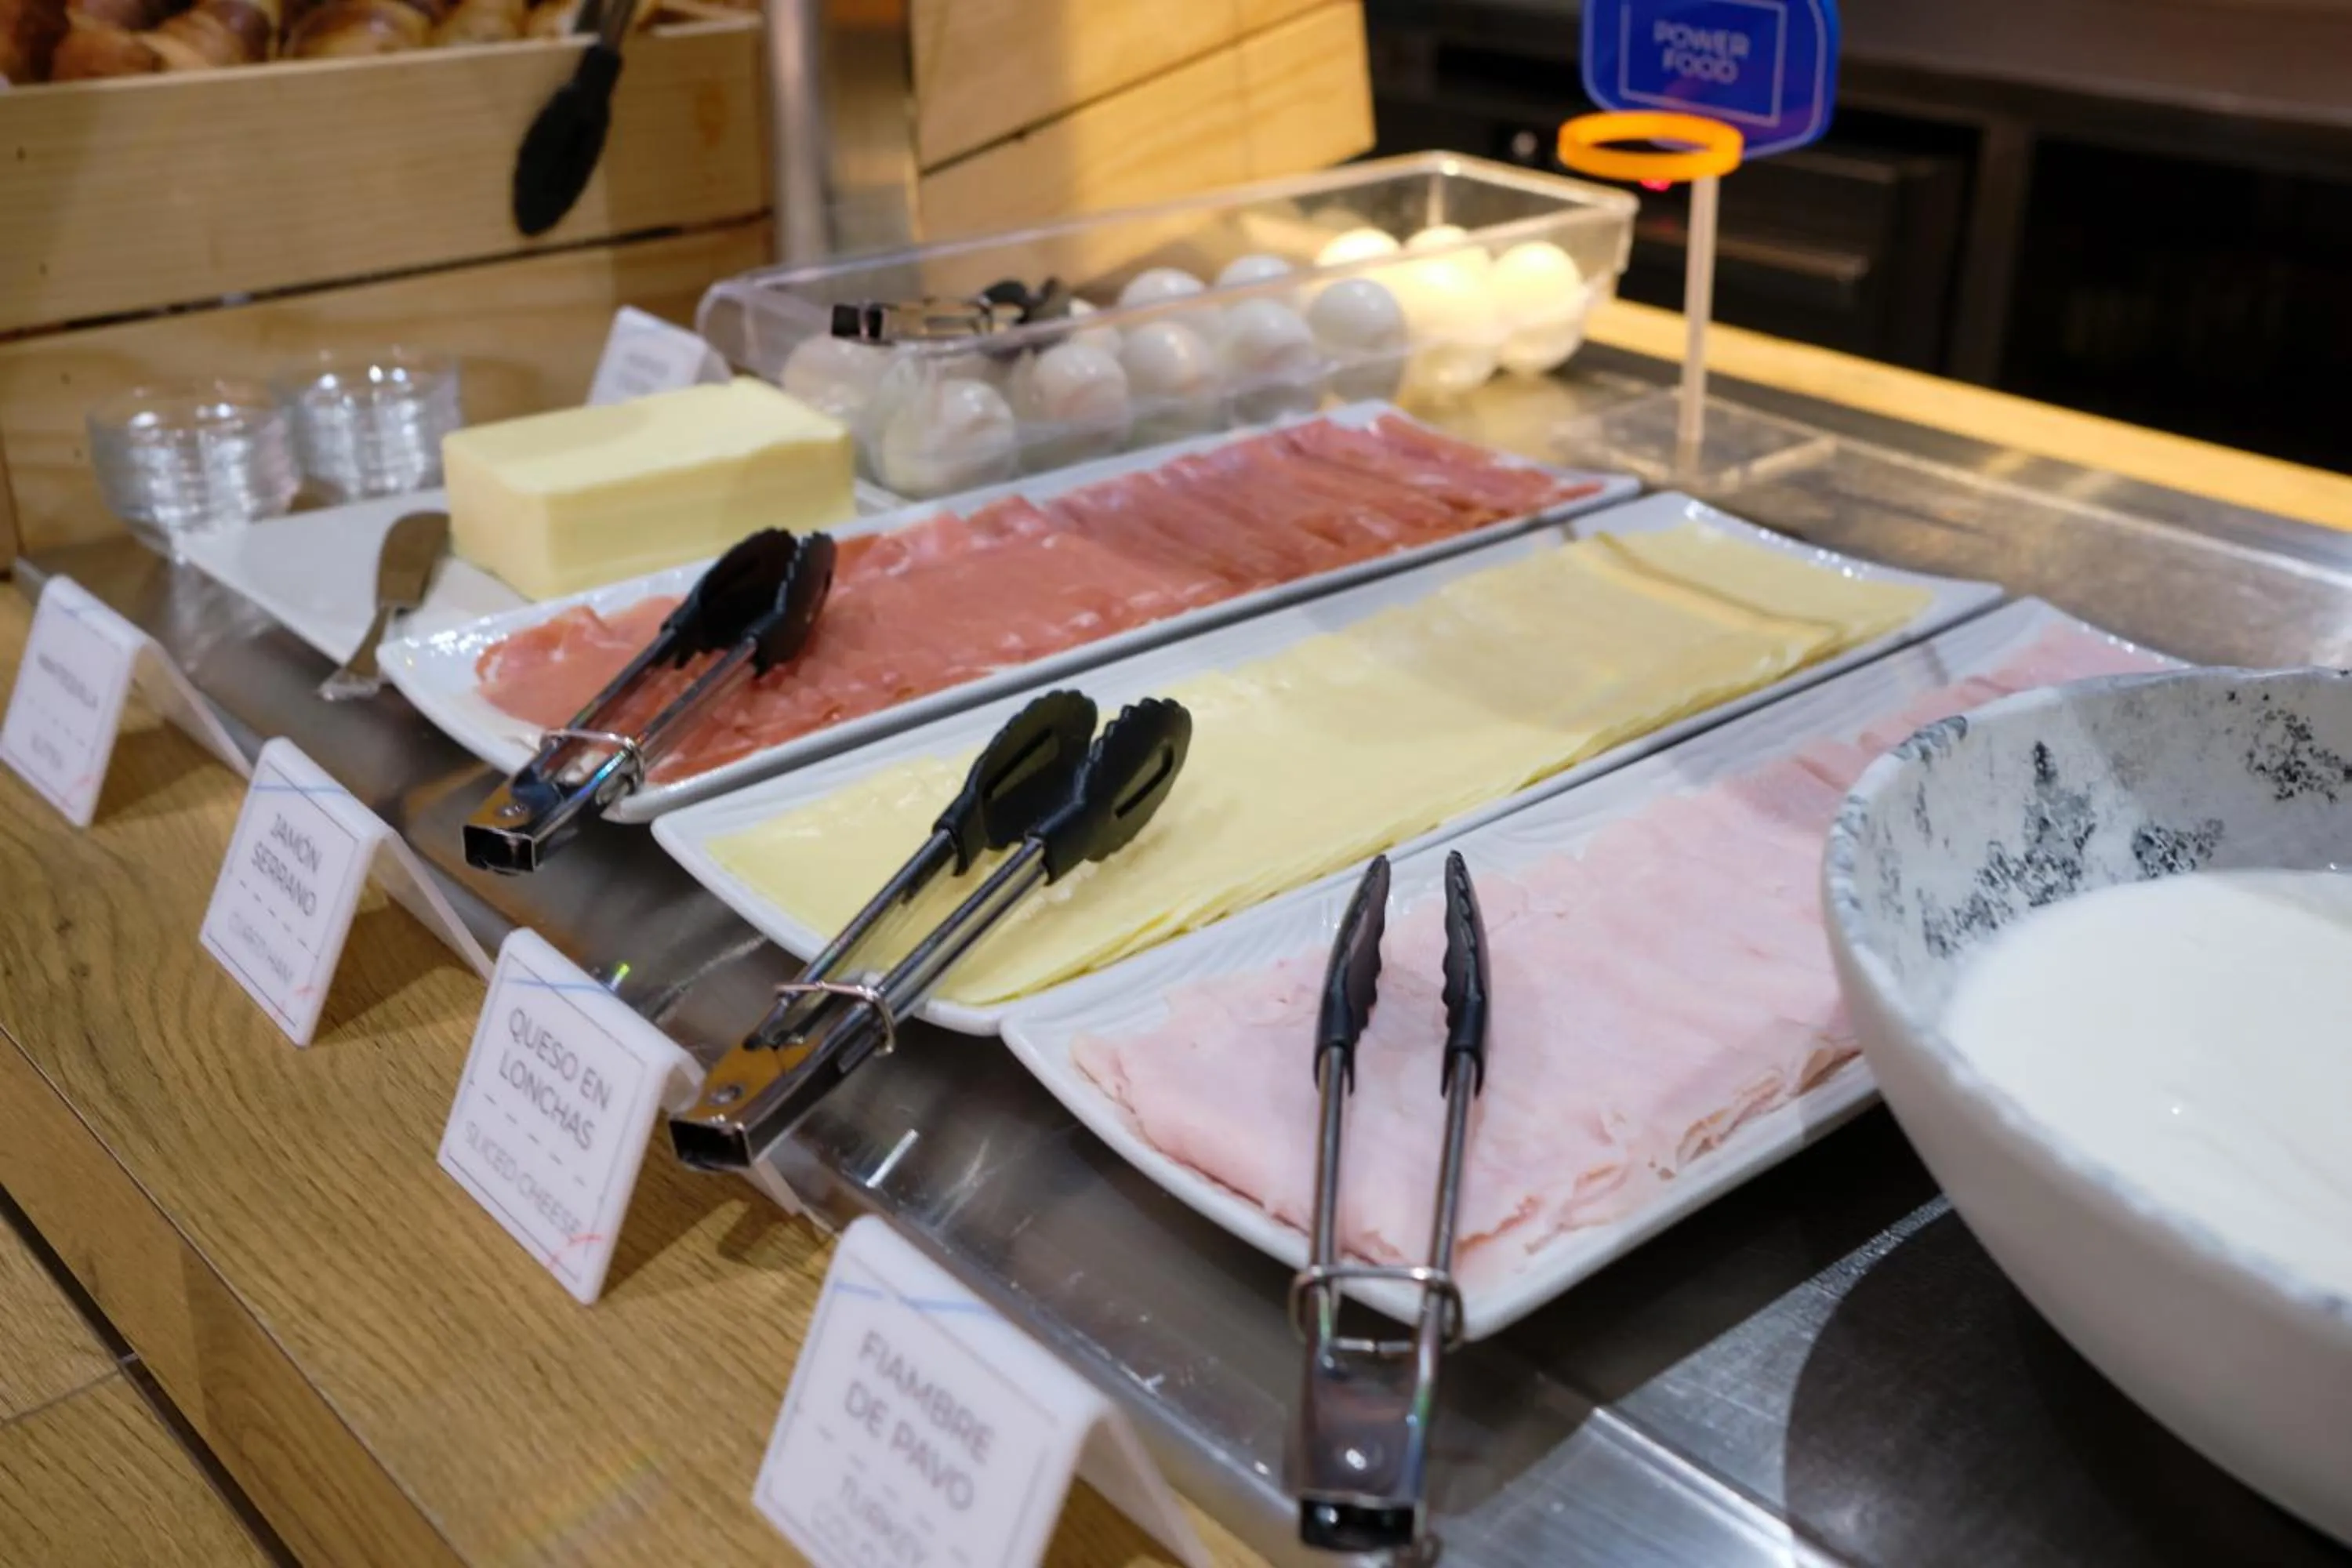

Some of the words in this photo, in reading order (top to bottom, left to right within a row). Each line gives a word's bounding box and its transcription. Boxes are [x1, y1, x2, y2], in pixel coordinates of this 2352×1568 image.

[1653, 20, 1751, 59] POWER
[1661, 47, 1739, 84] FOOD
[251, 840, 318, 917] SERRANO
[498, 1051, 597, 1151] LONCHAS
[508, 1006, 579, 1081] QUESO
[579, 1065, 613, 1112] EN
[464, 1120, 517, 1182] SLICED
[516, 1170, 583, 1243] CHEESE
[844, 1379, 889, 1439] DE
[889, 1417, 975, 1512] PAVO
[858, 1328, 996, 1465] FIAMBRE
